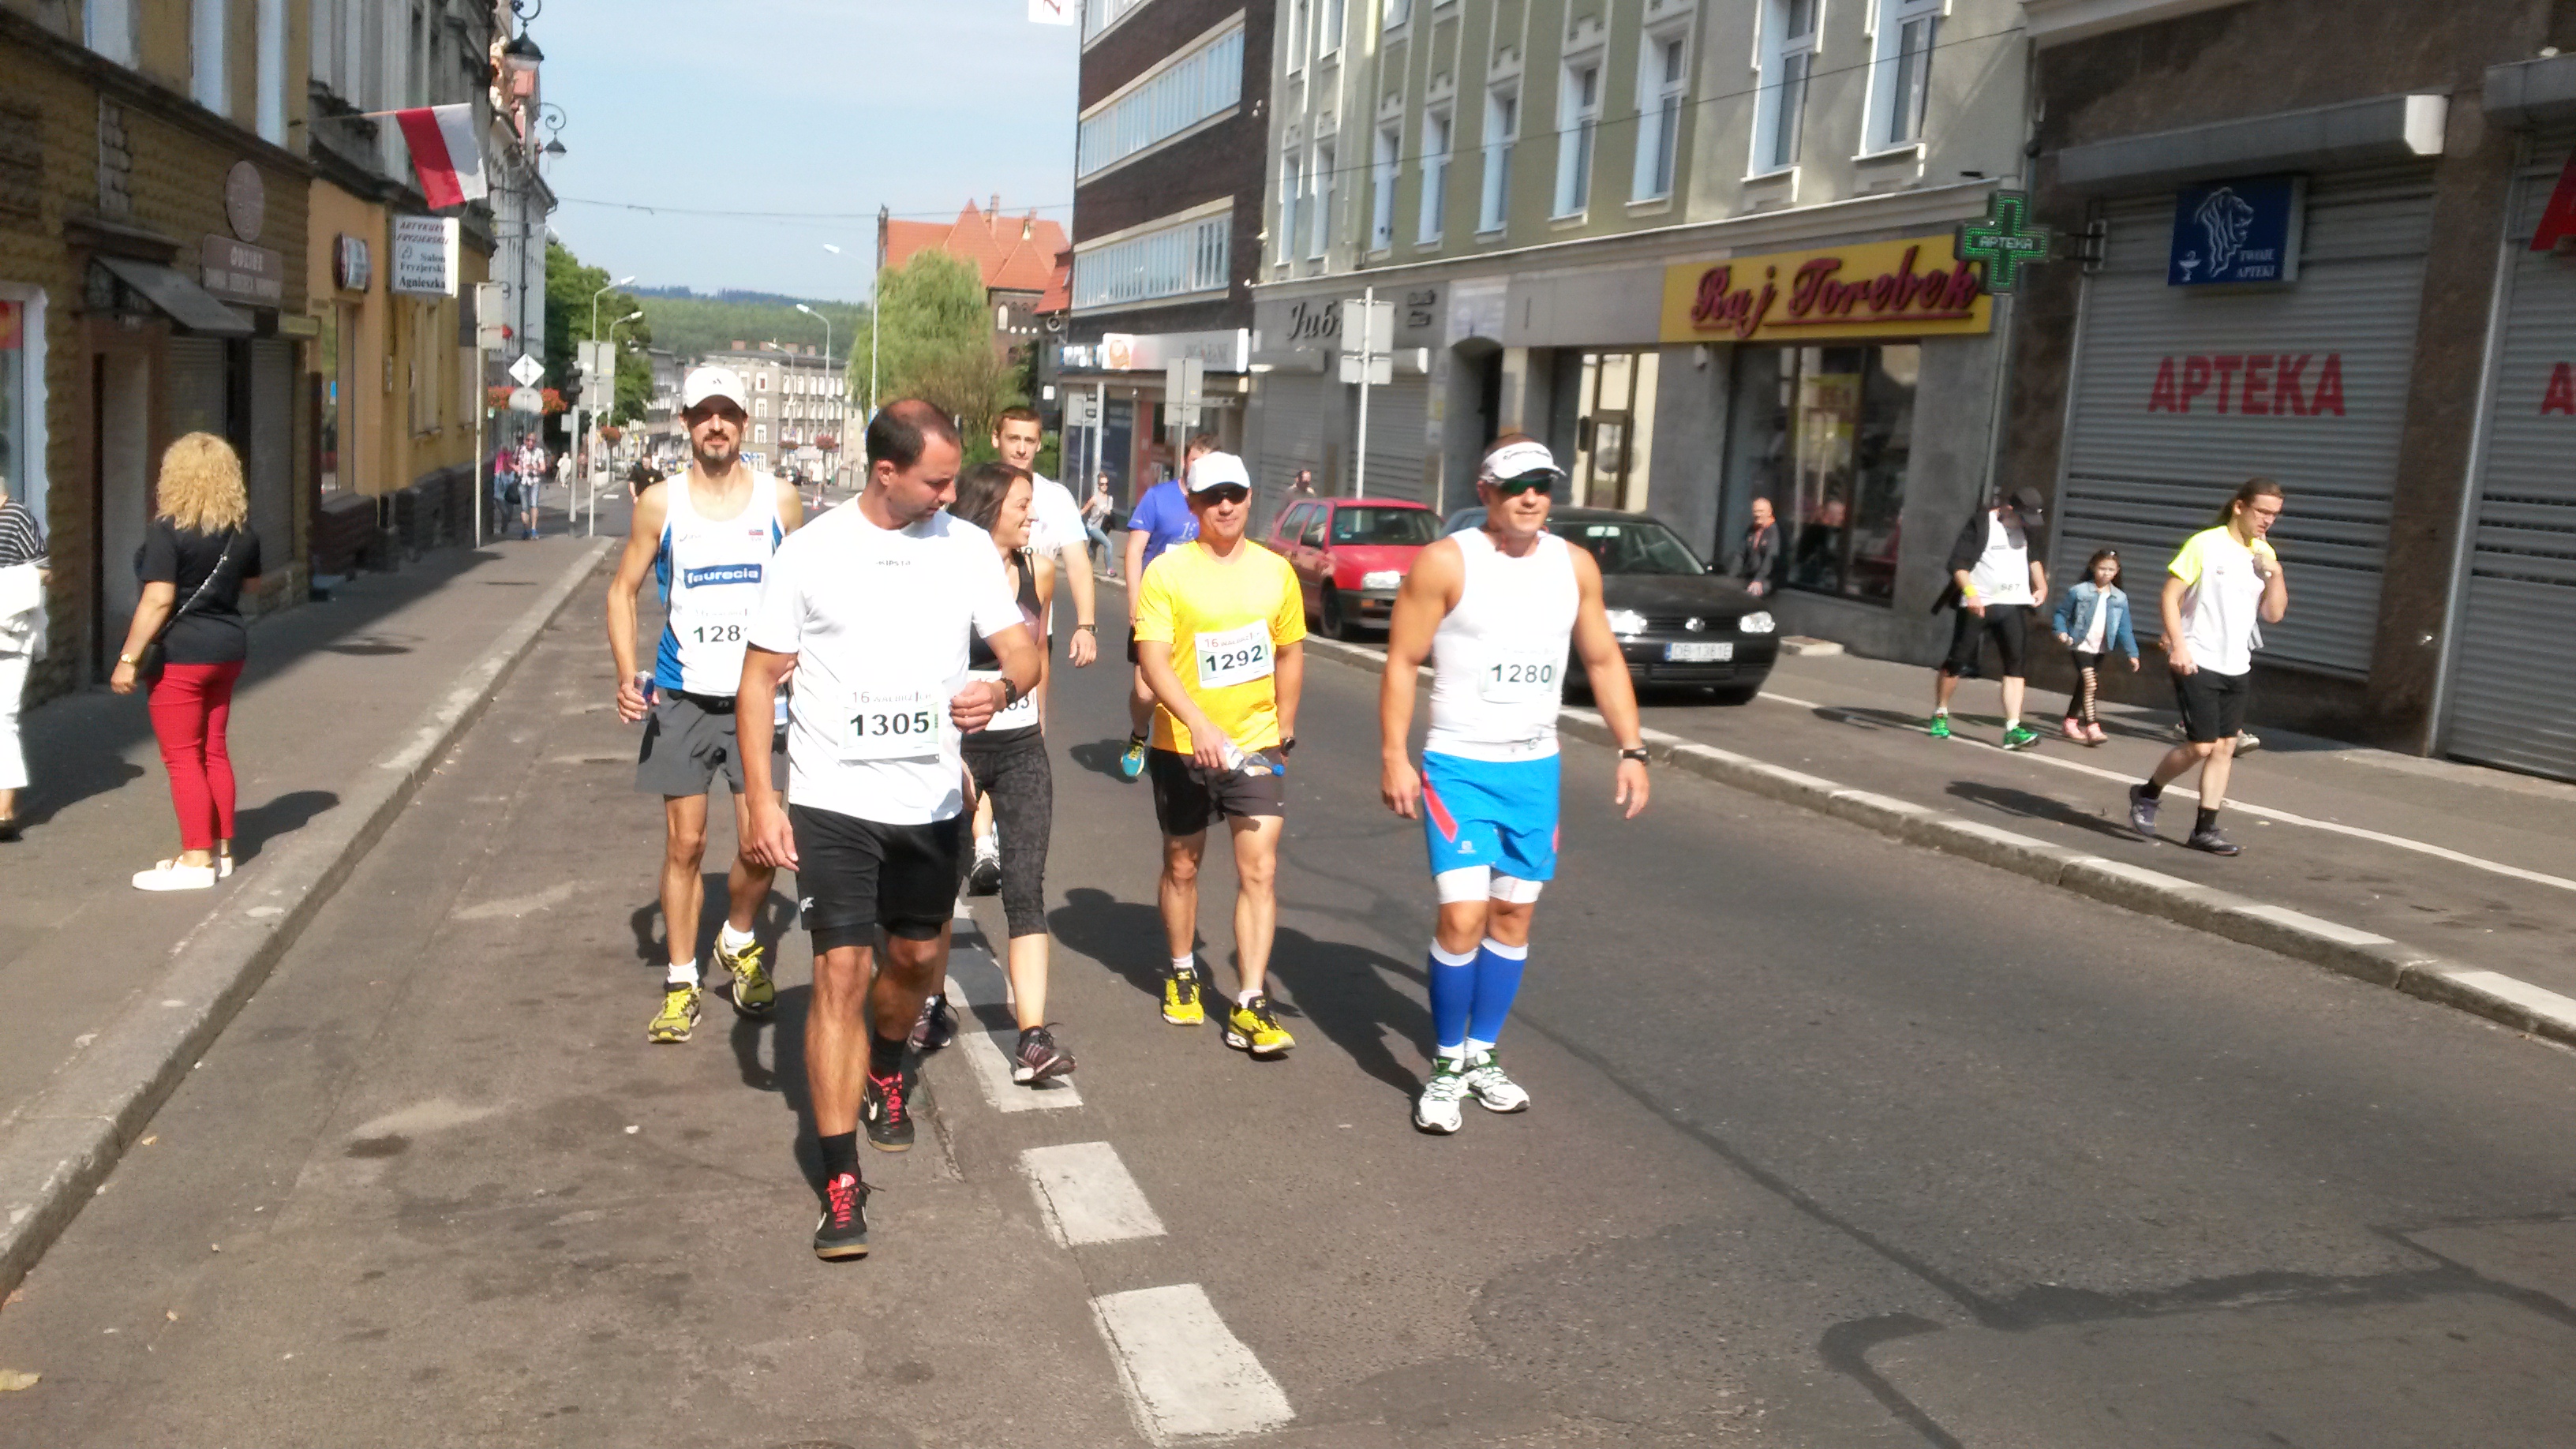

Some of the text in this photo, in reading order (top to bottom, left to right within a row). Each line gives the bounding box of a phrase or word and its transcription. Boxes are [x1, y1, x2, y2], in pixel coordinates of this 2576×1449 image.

[1978, 235, 2034, 250] APTEKA
[399, 275, 446, 289] Agnieszka
[1691, 245, 1981, 339] Raj Torebek
[2147, 353, 2346, 417] APTEKA
[687, 567, 759, 584] faurecia
[693, 623, 748, 644] 128
[1204, 638, 1219, 648] 16
[1205, 645, 1264, 672] 1292
[1491, 663, 1552, 683] 1280
[852, 691, 871, 704] 16
[850, 711, 930, 736] 1305
